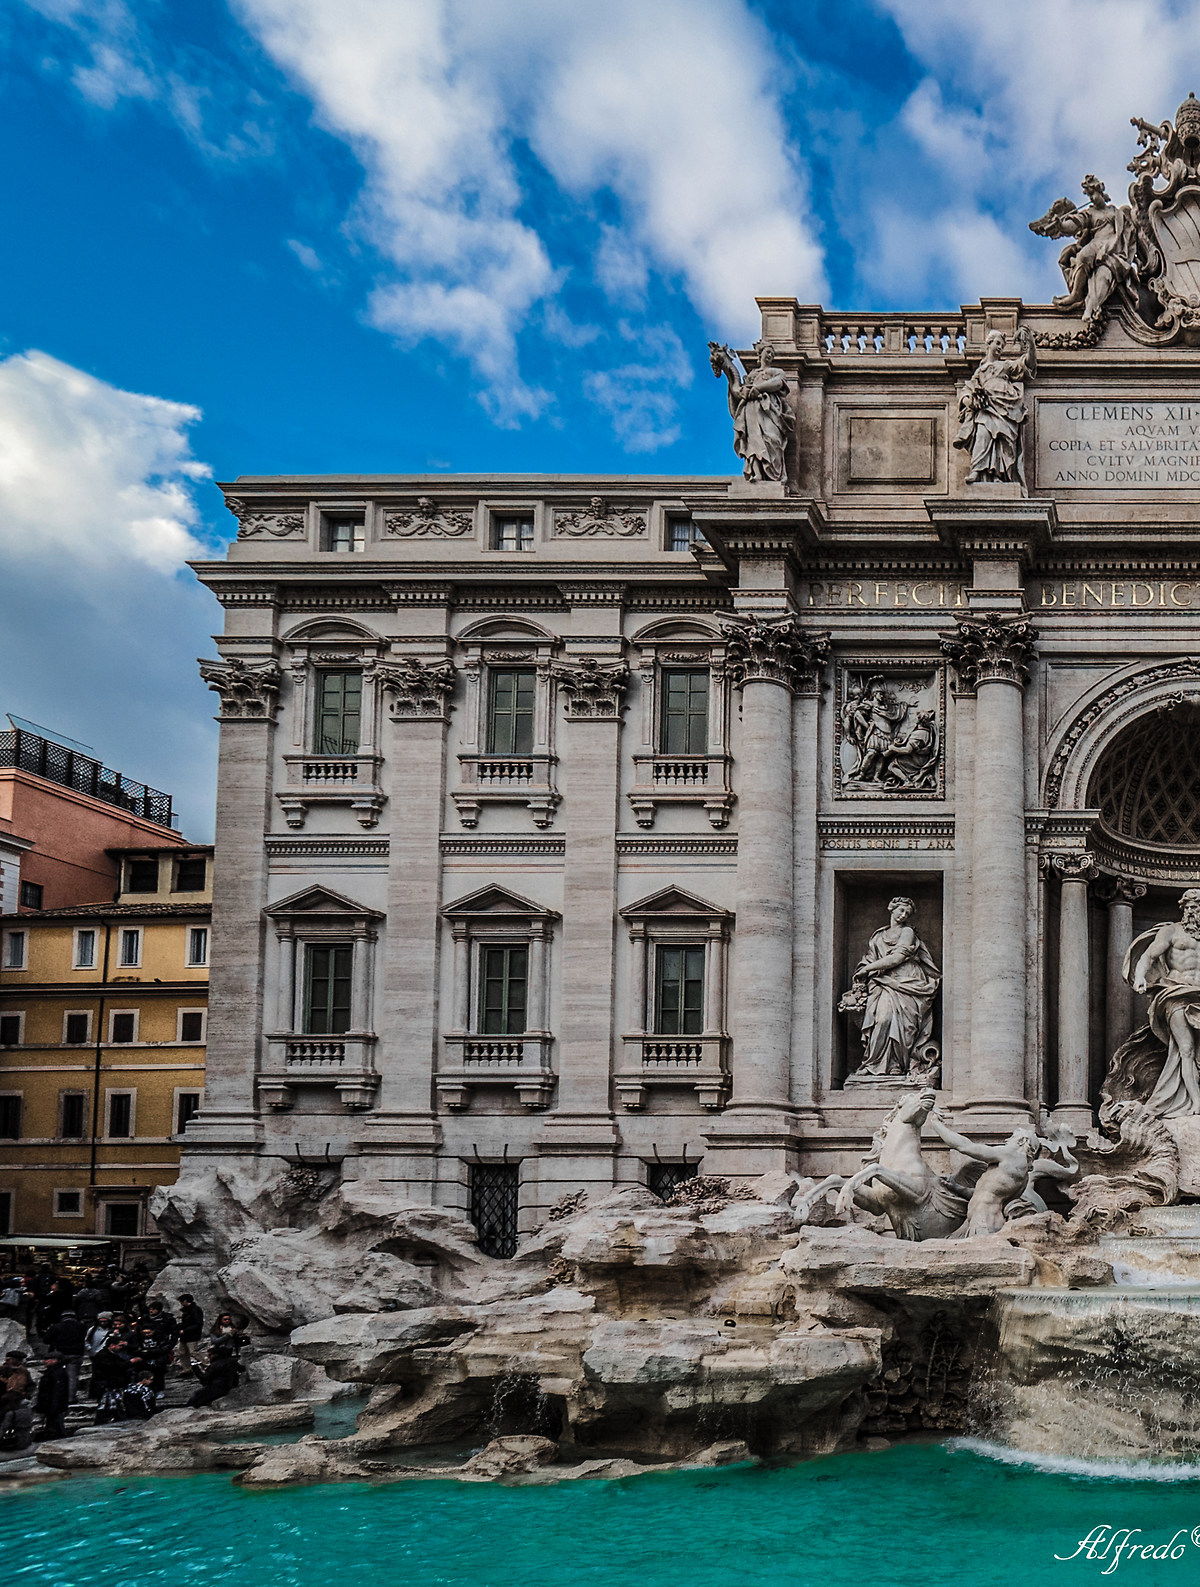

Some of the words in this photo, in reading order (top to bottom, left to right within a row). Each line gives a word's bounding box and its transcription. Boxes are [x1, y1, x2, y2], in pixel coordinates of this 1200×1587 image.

[1066, 406, 1154, 421] CLEMENS
[1125, 425, 1179, 439] AQVAM
[1049, 440, 1092, 451] COPIA
[1100, 440, 1115, 451] ET
[1086, 455, 1135, 467] CVLTV
[1055, 470, 1099, 482] ANNO
[1105, 470, 1159, 482] DOMINI
[807, 581, 969, 607] PERFECIT
[822, 839, 861, 849] POSITIS
[866, 839, 900, 849] SIGNIS
[907, 839, 920, 849] ET
[927, 839, 954, 849] ANA
